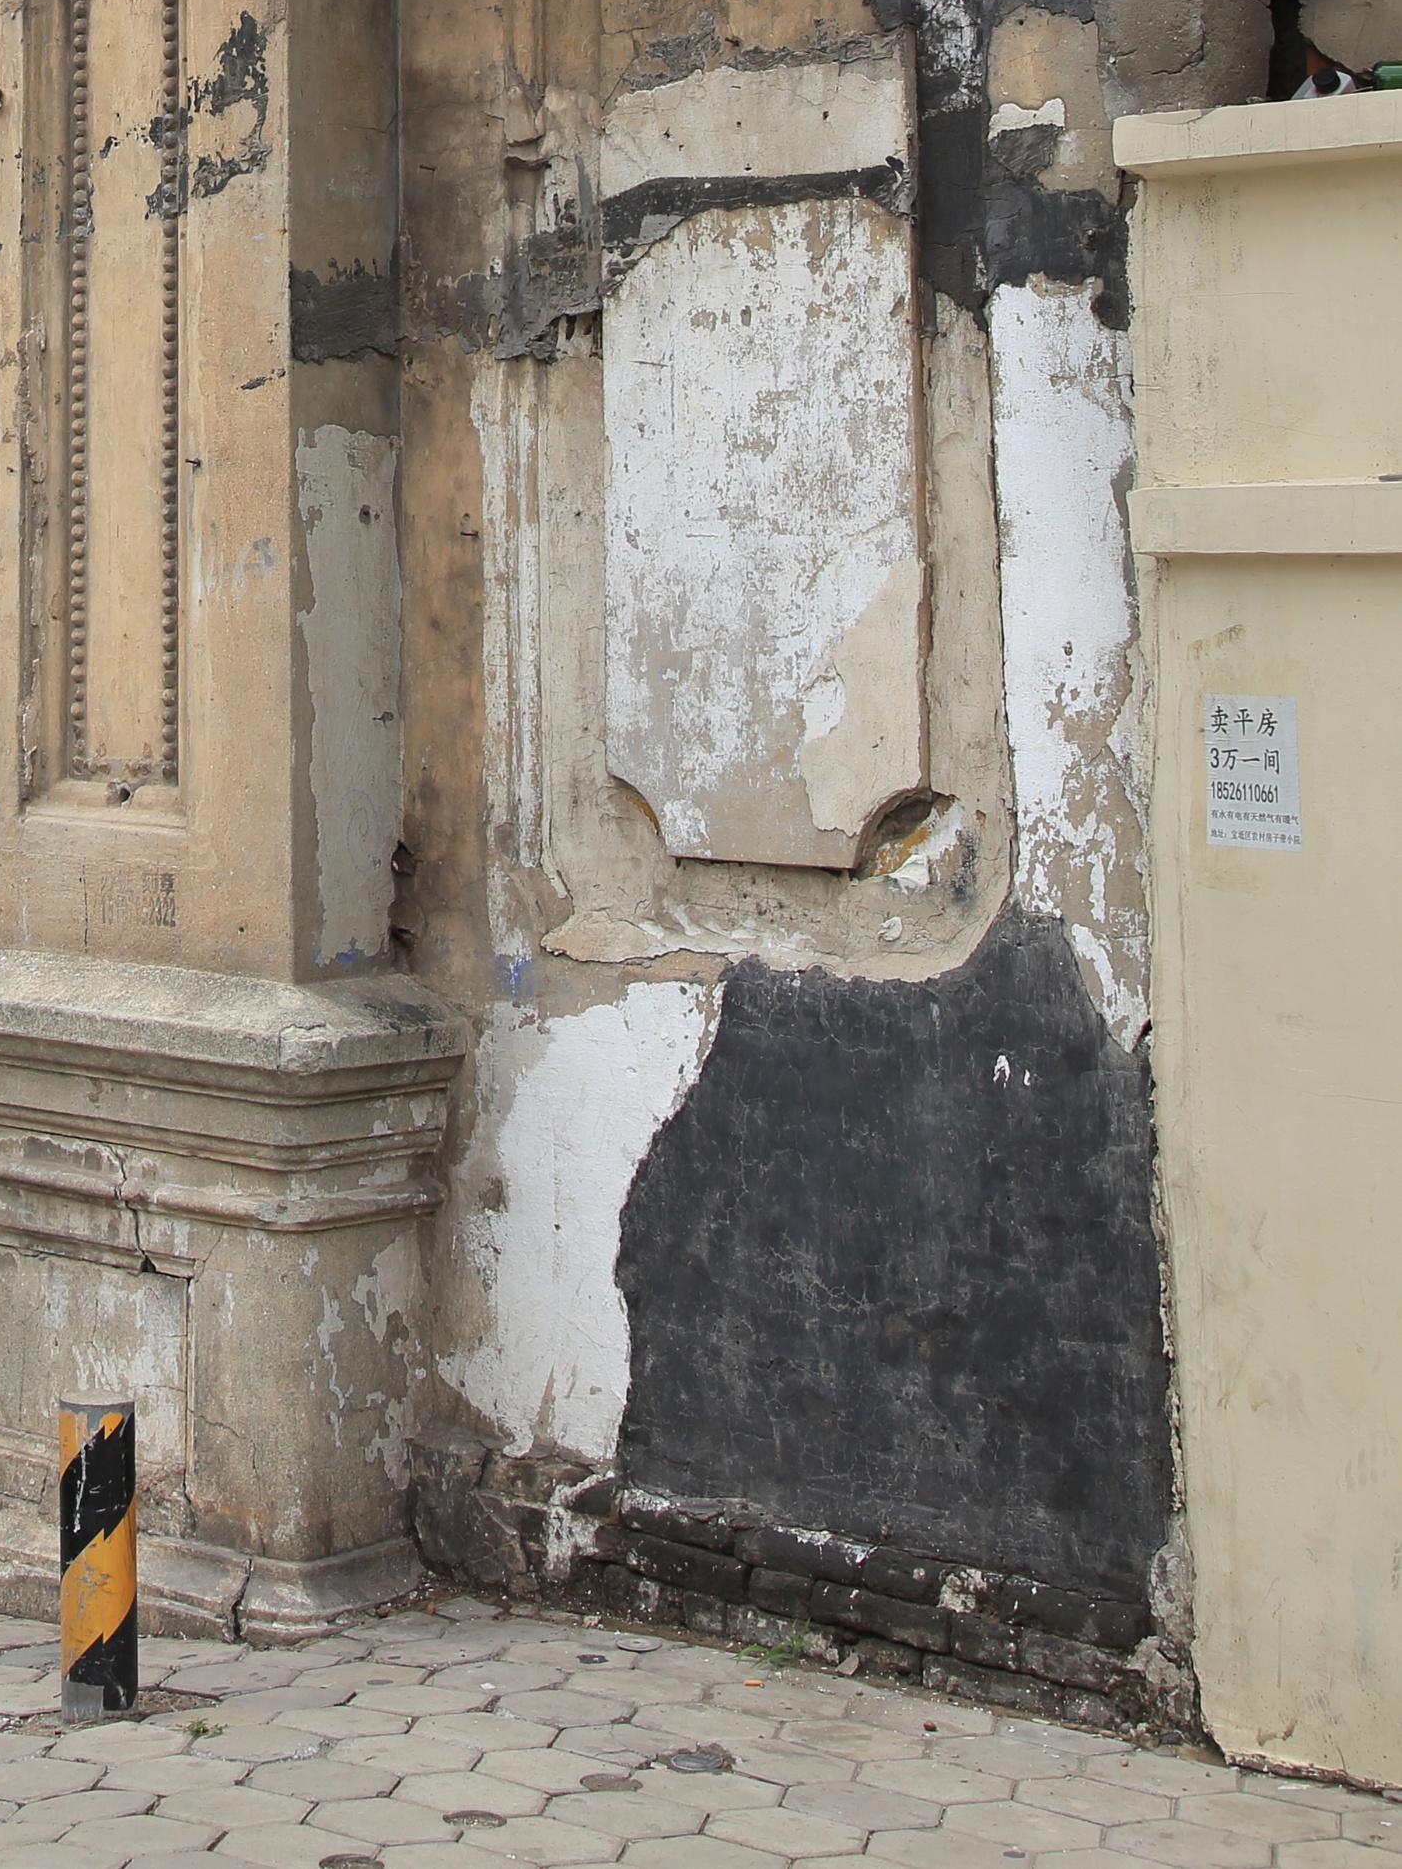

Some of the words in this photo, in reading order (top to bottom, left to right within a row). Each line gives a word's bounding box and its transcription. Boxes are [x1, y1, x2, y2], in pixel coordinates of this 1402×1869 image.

[1210, 706, 1279, 737] 卖平房
[1210, 747, 1281, 775] 3万一间
[1210, 781, 1279, 804] 18526110661
